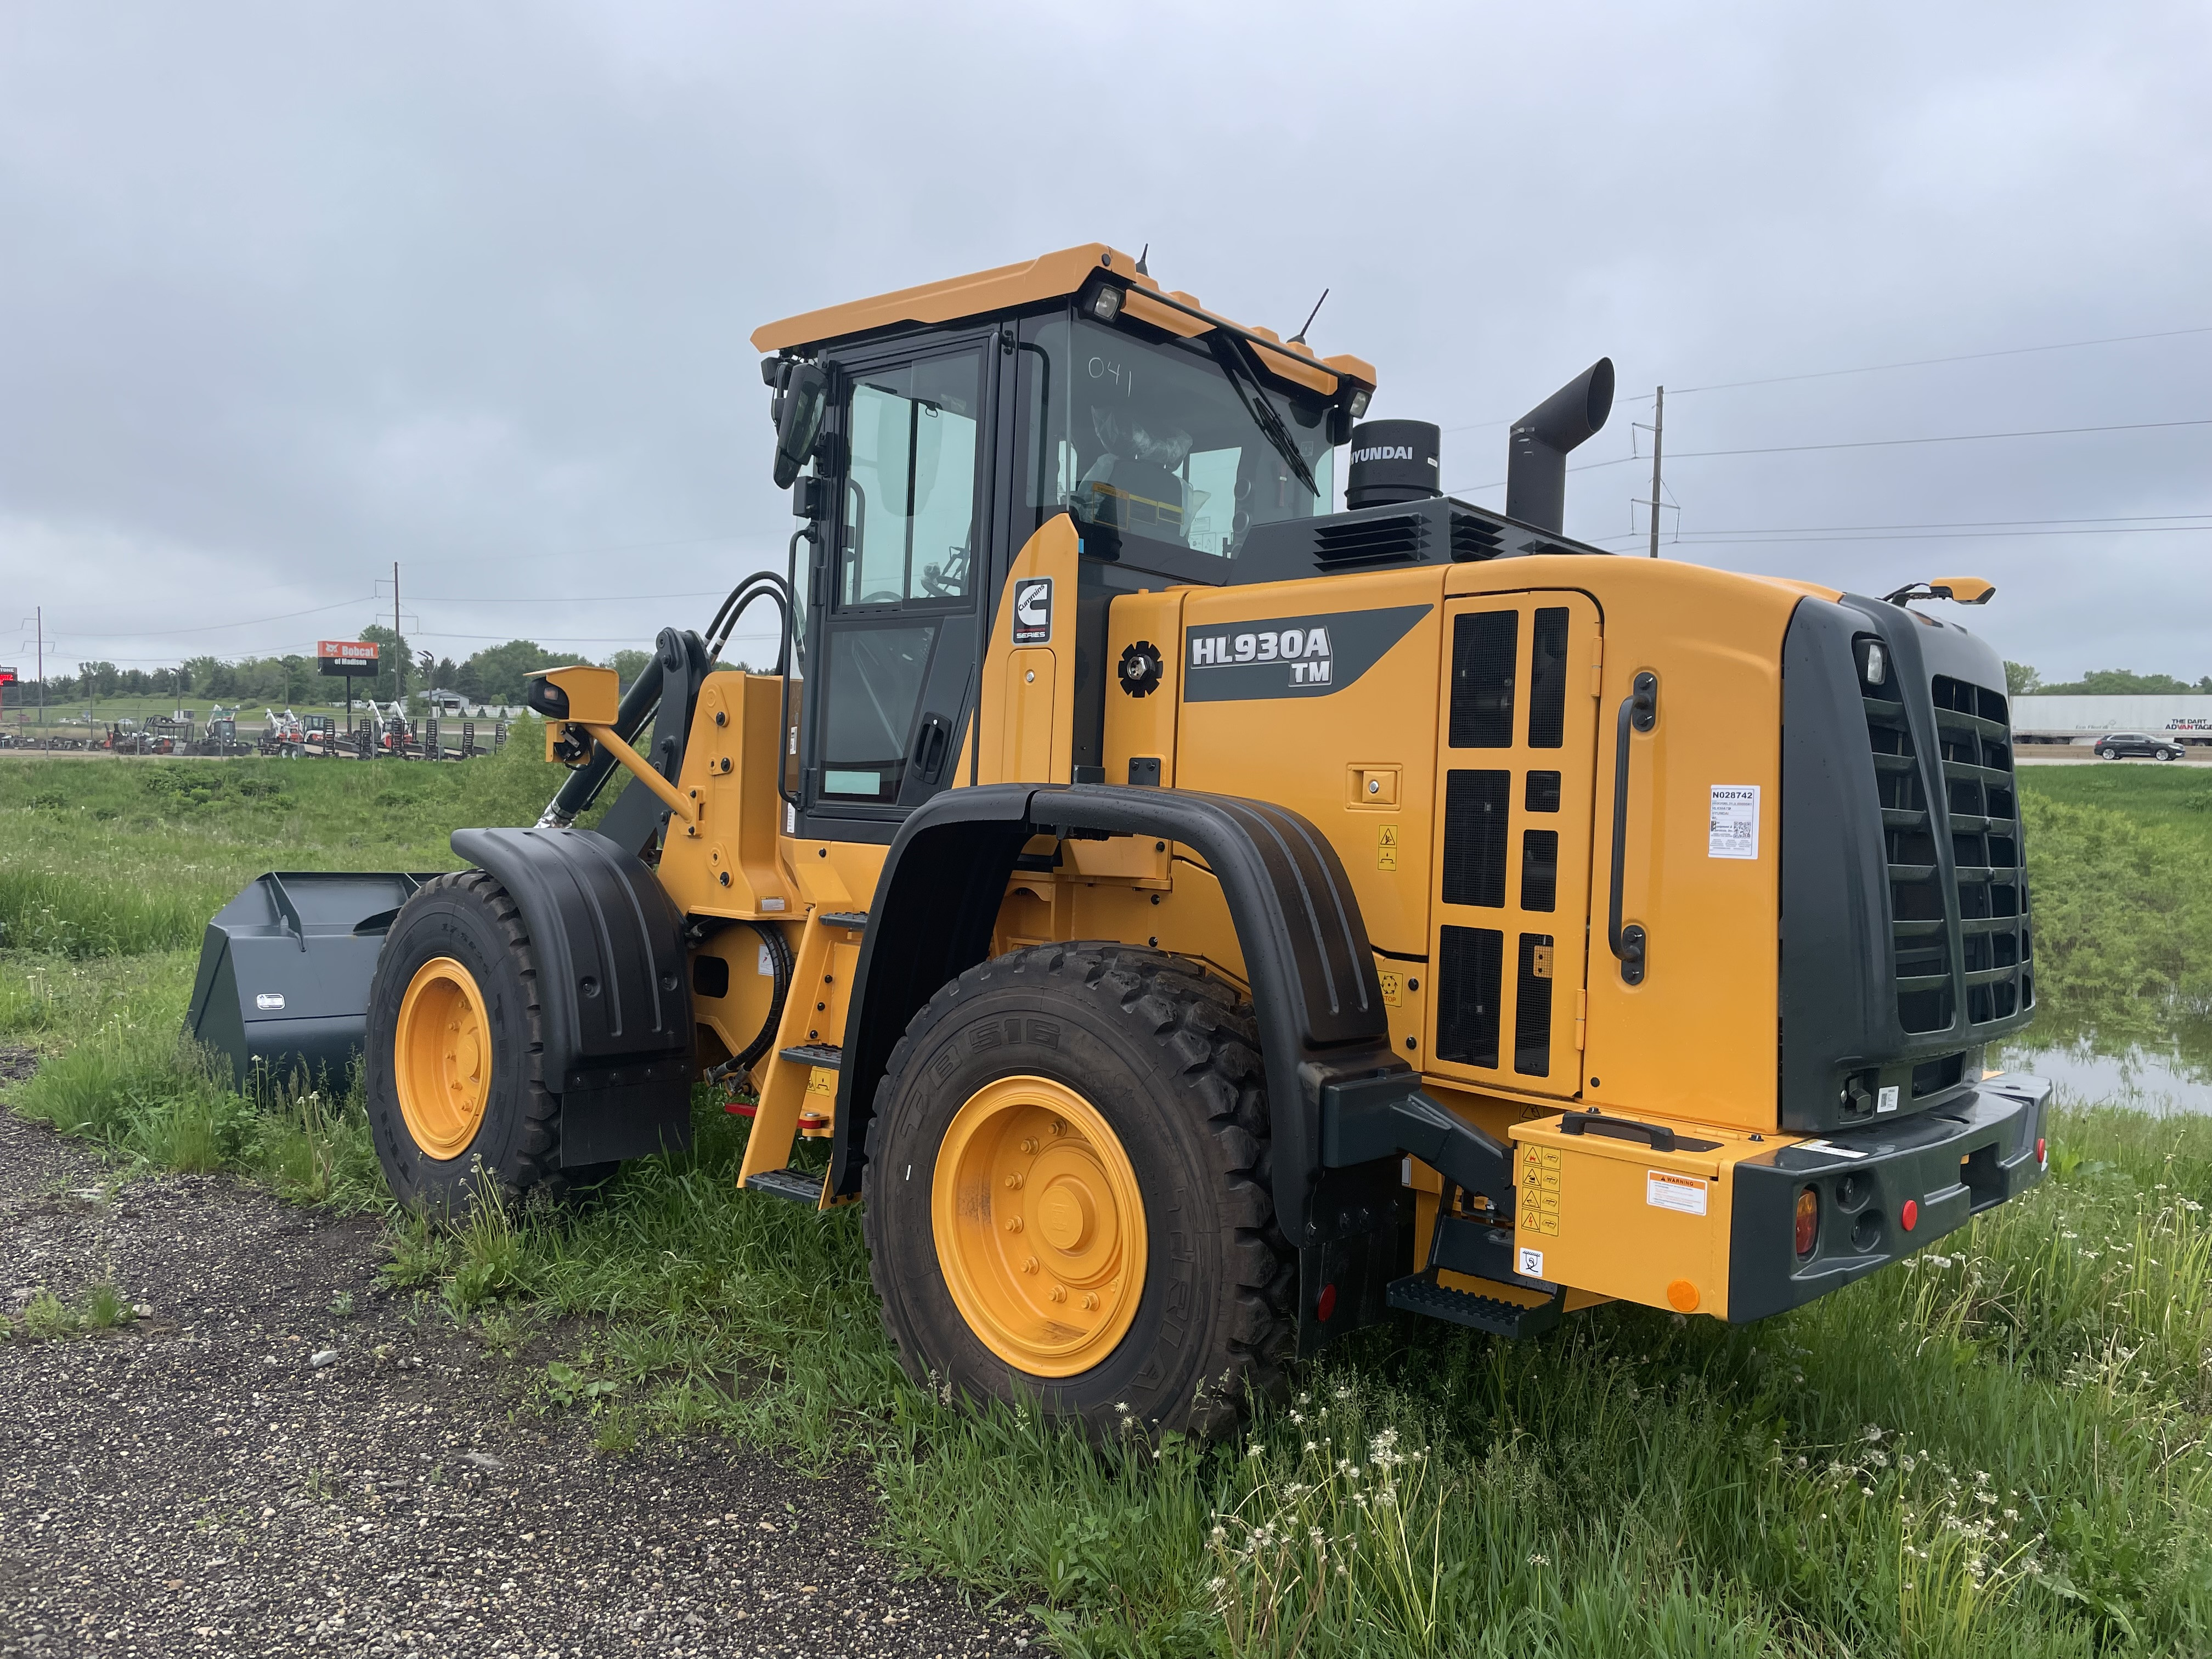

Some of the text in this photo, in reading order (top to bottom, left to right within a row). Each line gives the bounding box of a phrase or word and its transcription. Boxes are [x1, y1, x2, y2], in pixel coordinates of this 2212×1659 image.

[1088, 357, 1132, 397] 041
[1350, 446, 1413, 466] HYUNDAI
[1018, 584, 1045, 611] Cummins
[342, 645, 374, 657] Bobcat
[1192, 628, 1330, 665] HL930A
[1291, 661, 1330, 683] TM
[900, 1018, 1061, 1137] TB516
[1667, 1177, 1694, 1186] WARNING
